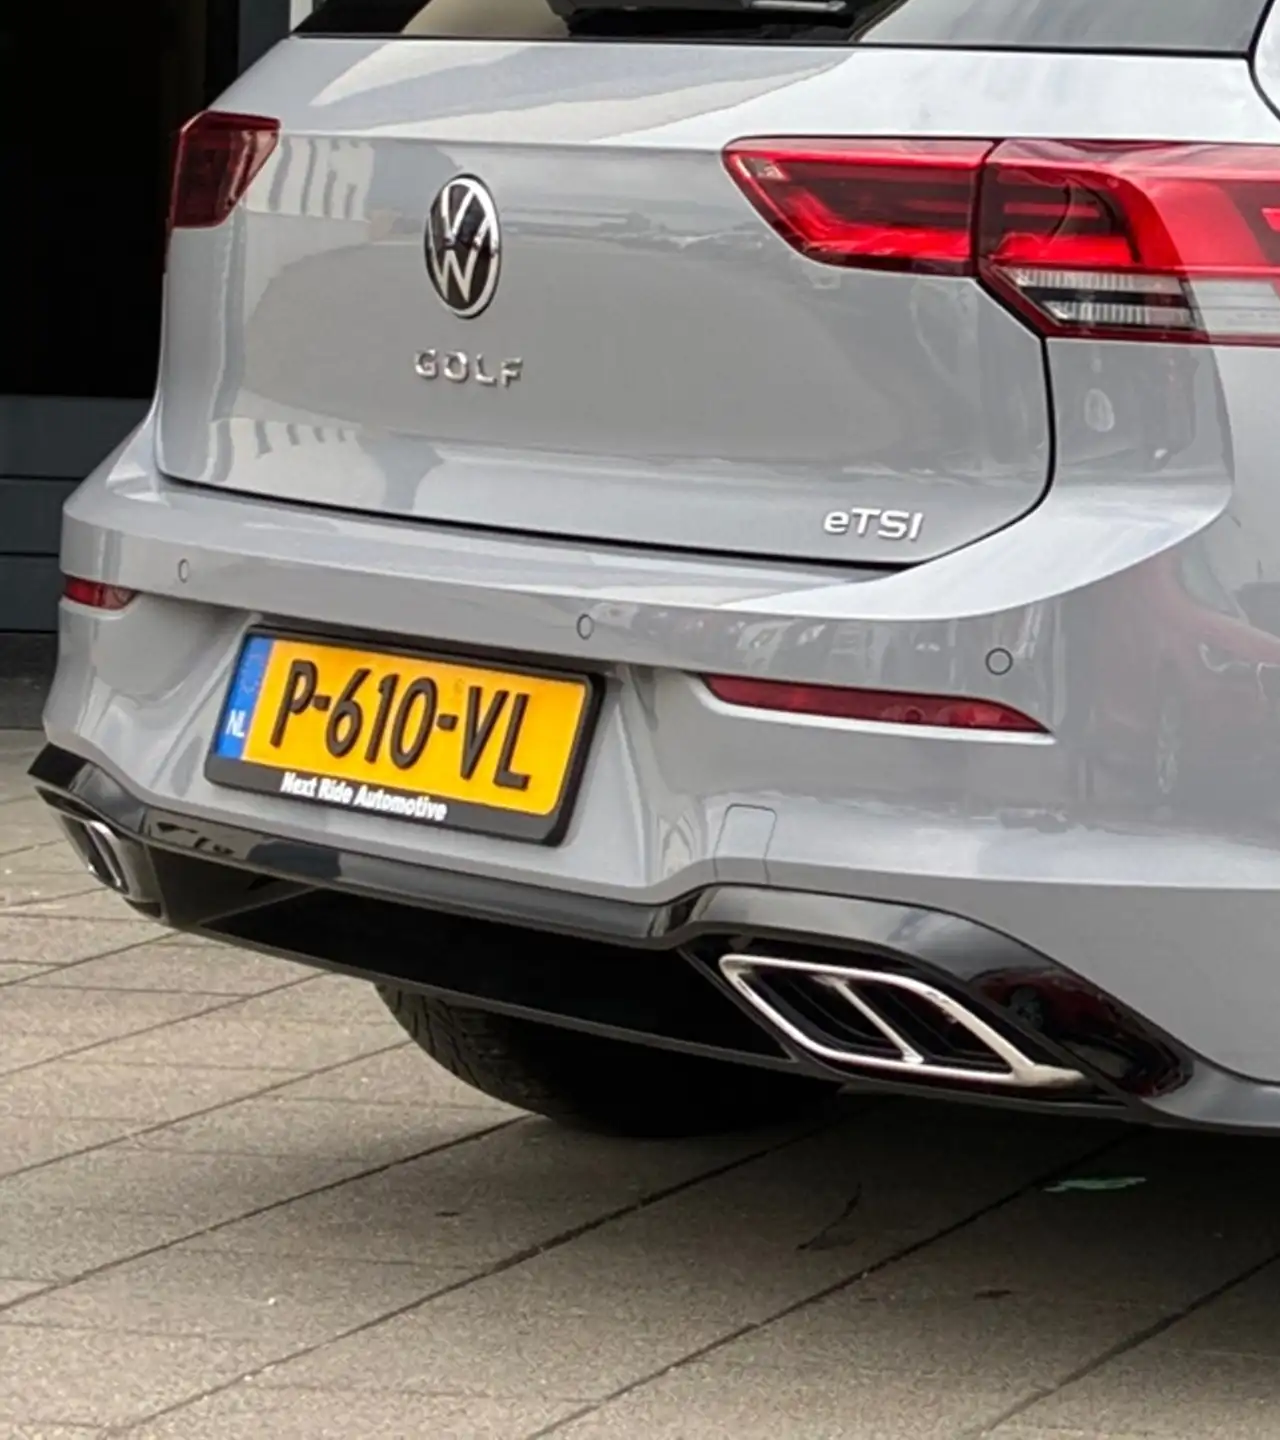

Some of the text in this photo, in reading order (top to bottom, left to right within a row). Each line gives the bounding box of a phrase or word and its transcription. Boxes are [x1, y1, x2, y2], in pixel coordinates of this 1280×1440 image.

[414, 349, 523, 388] GOLF
[823, 507, 924, 541] eTSI
[226, 709, 246, 738] NL
[269, 658, 531, 791] P-610-VL
[280, 771, 447, 821] Next Ride Automotive
